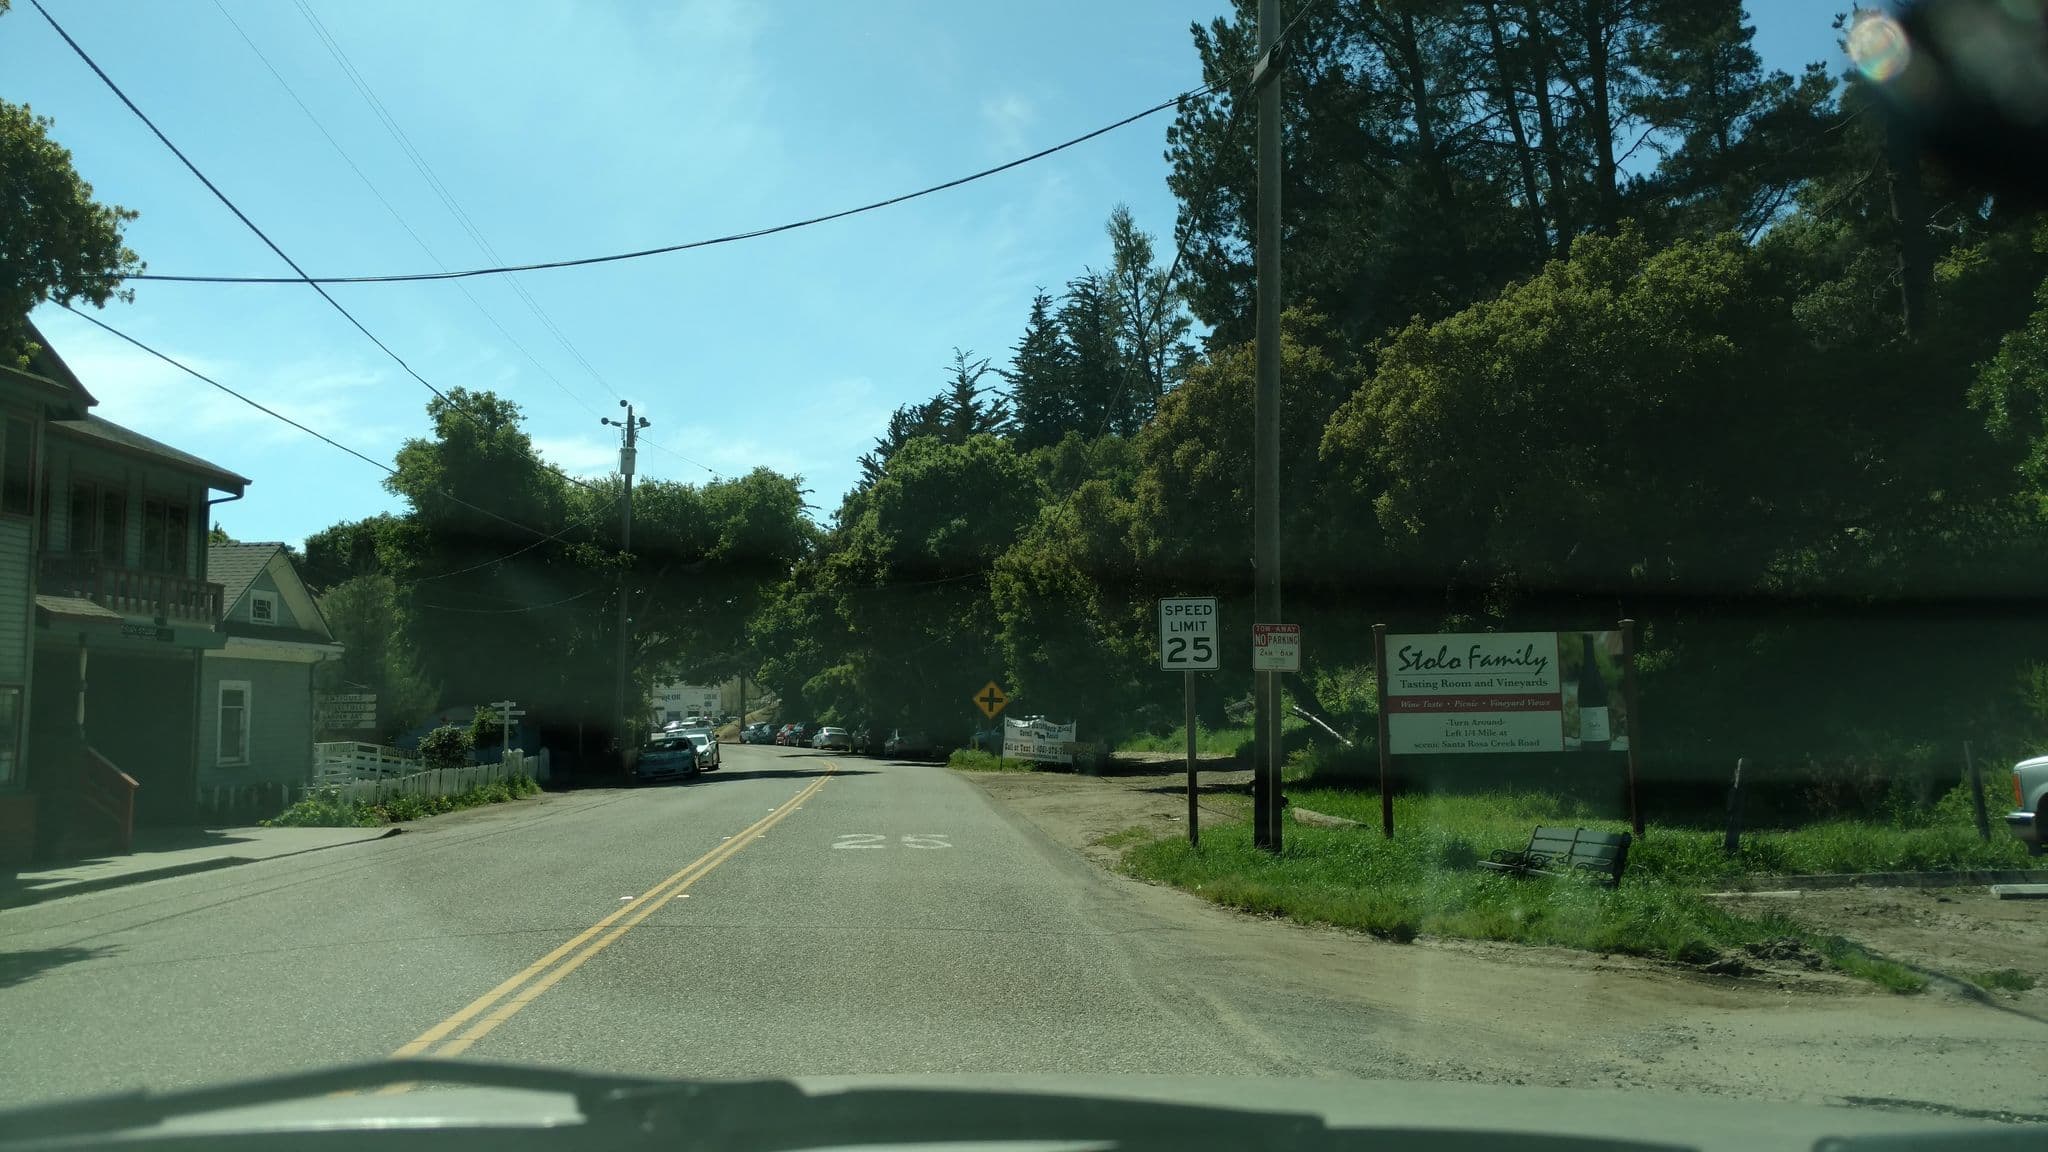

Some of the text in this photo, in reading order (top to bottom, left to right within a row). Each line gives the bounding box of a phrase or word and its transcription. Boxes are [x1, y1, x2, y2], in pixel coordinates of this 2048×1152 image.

[1165, 605, 1212, 616] SPEED
[1170, 620, 1207, 632] LIMIT
[1255, 633, 1298, 646] NO PARKING
[1167, 637, 1213, 663] 25
[1398, 643, 1549, 675] Stolo Family
[1400, 677, 1549, 690] Tasting Room and Vineyards
[1400, 700, 1420, 708] Wine
[1445, 729, 1461, 737] Left
[1478, 728, 1496, 736] Mile
[1441, 740, 1466, 748] Santa
[1468, 740, 1489, 748] Rosa
[1491, 739, 1516, 747] Creek
[1518, 739, 1540, 747] Road
[831, 834, 952, 849] 25
